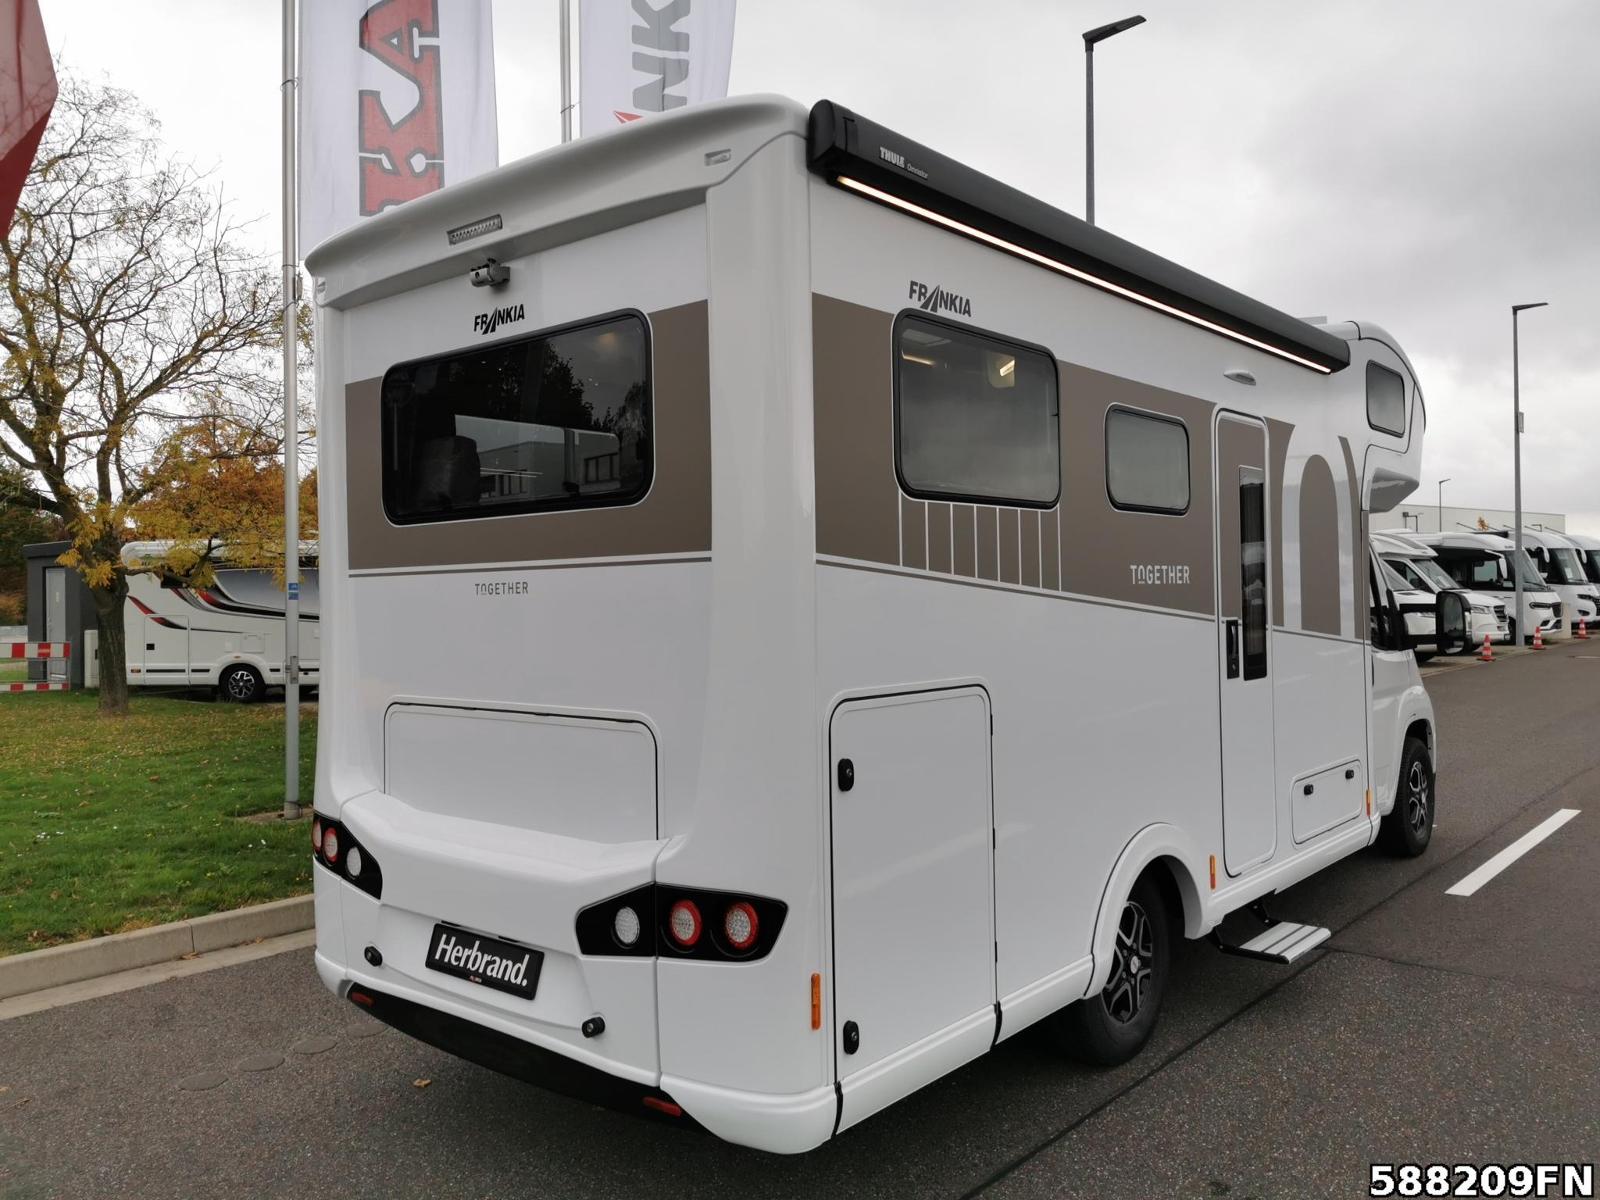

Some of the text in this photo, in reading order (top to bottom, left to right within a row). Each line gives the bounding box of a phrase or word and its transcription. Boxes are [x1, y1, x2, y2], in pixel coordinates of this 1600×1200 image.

[613, 0, 691, 124] NK
[880, 146, 905, 168] THULE
[908, 280, 971, 317] FRANKIA
[474, 304, 525, 335] FRANKIA
[475, 582, 528, 596] TOGETHER
[1130, 564, 1190, 584] TOGETHER
[435, 933, 530, 987] Herbrand.
